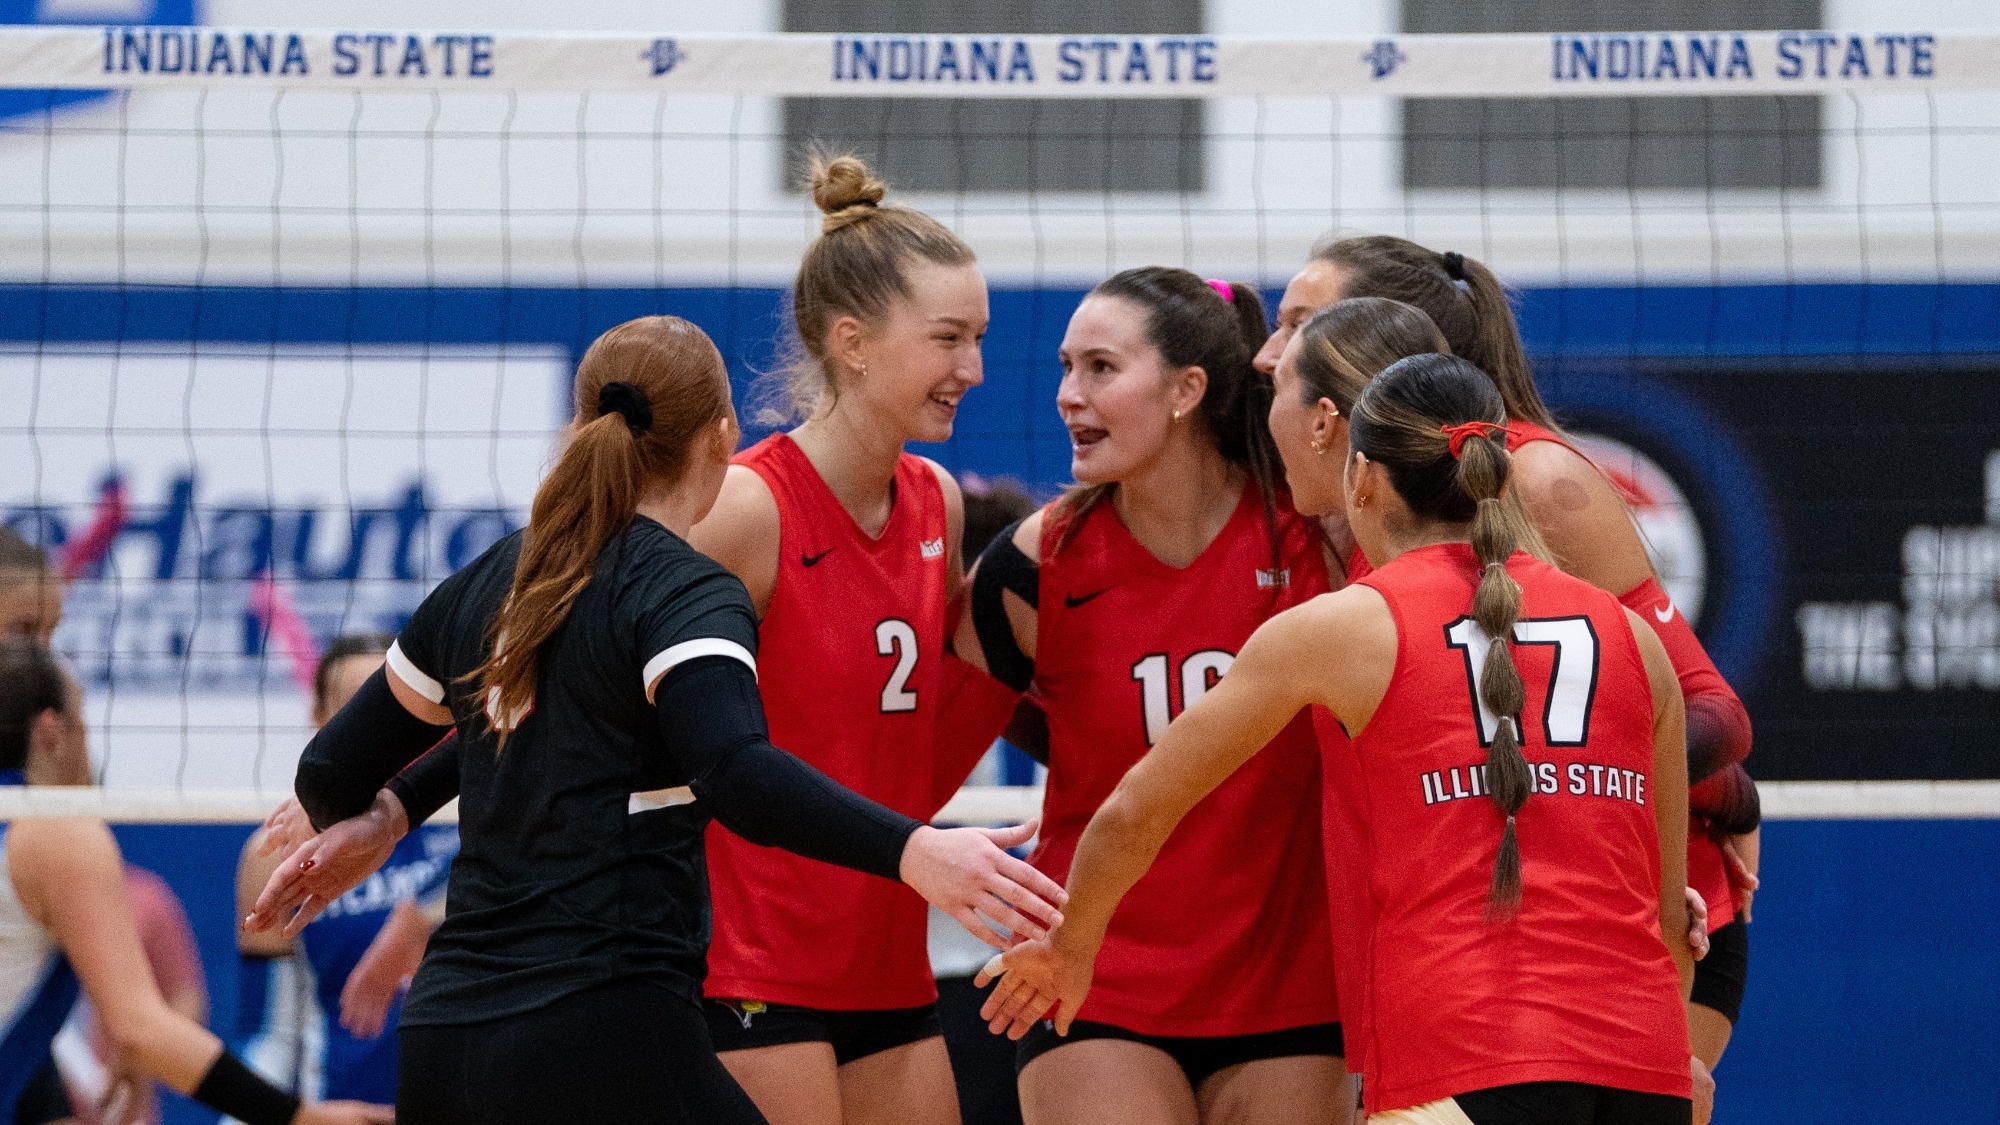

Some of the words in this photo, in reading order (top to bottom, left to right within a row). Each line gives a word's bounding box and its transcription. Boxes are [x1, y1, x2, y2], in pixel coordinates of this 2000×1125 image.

[102, 30, 311, 76] INDIANA
[331, 33, 495, 79] STATE
[832, 38, 1038, 83] INDIANA
[1056, 39, 1218, 84] STATE
[1551, 34, 1756, 81] INDIANA
[1775, 32, 1936, 80] STATE
[874, 617, 918, 712] 2
[1443, 614, 1600, 748] 17
[1420, 762, 1559, 806] ILLIIS
[1566, 762, 1646, 805] STATE
